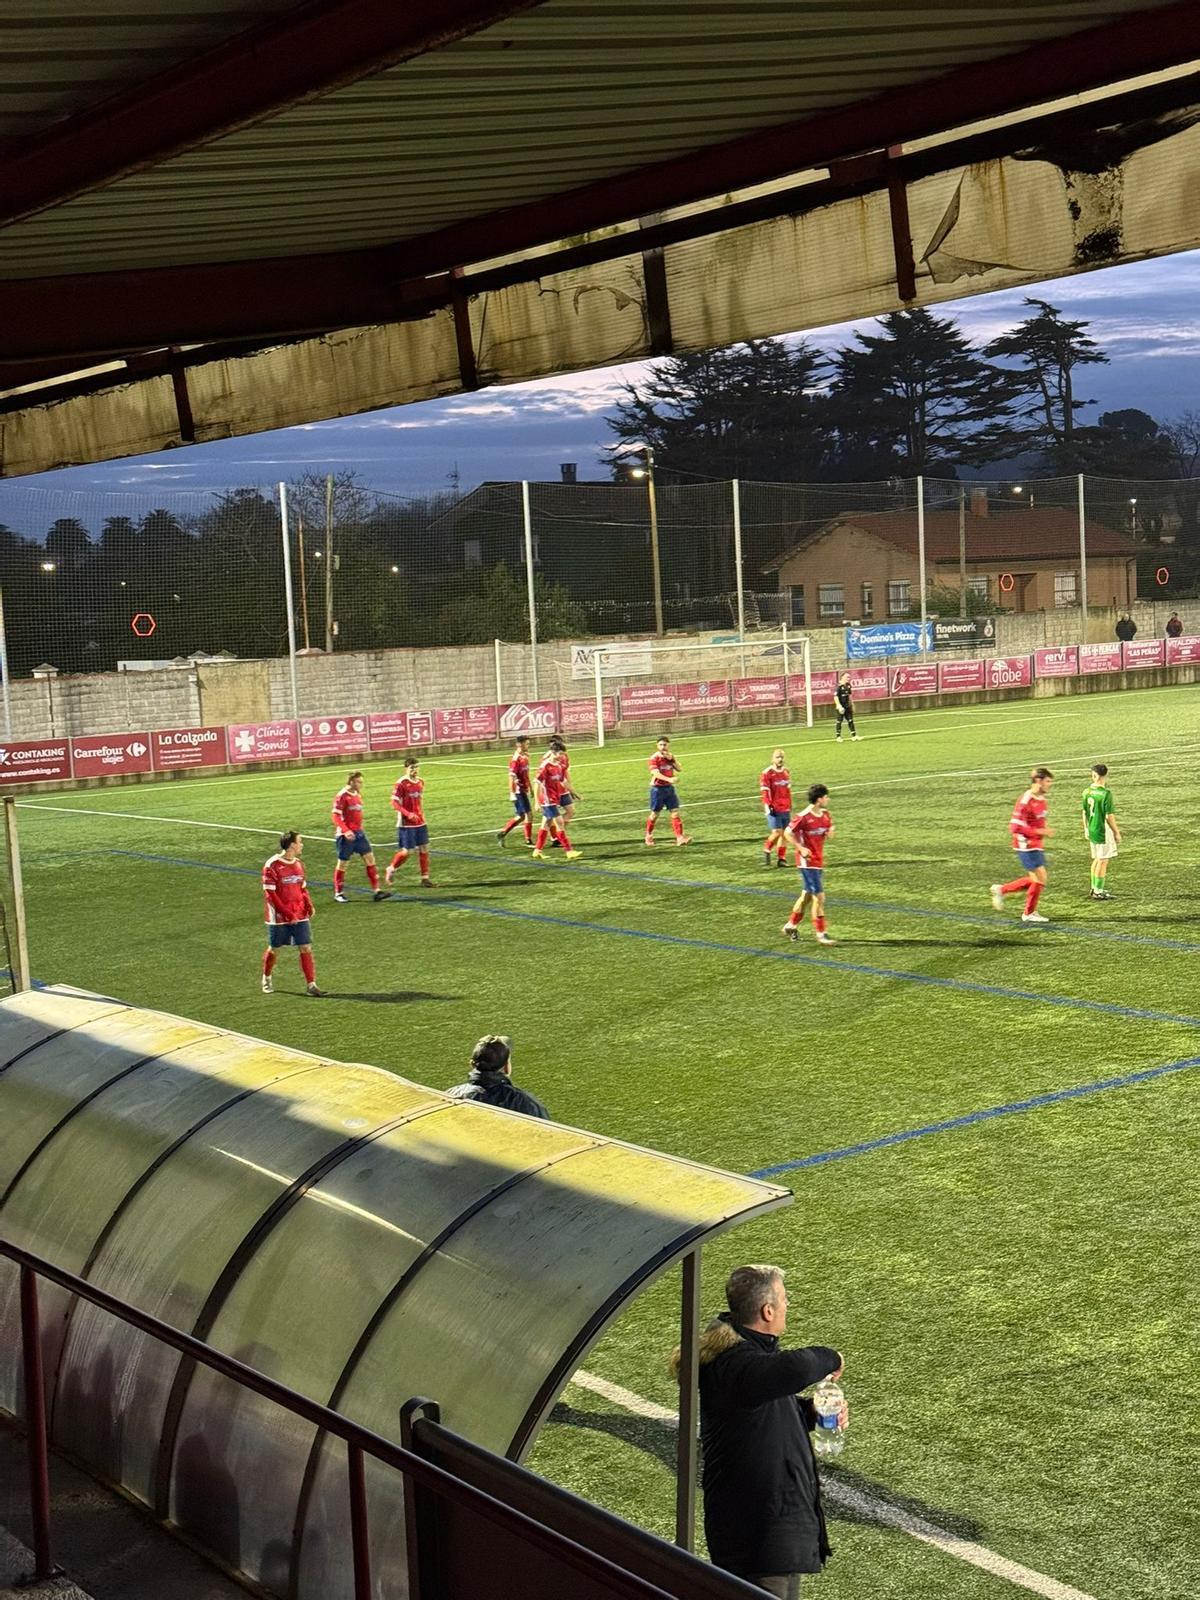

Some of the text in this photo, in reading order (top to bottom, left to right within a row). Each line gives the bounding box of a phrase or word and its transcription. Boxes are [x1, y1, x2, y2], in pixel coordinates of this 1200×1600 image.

[935, 623, 977, 634] finetwork
[860, 632, 915, 644] Domino's Pizza
[1045, 653, 1066, 664] fervi
[991, 669, 1022, 688] globe
[528, 712, 555, 729] MC
[158, 730, 218, 746] La Calzada
[256, 725, 291, 738] Clínica
[256, 738, 290, 752] Somió
[11, 748, 65, 760] CONTAKING
[73, 746, 124, 759] Carrefour
[101, 756, 125, 765] viajes
